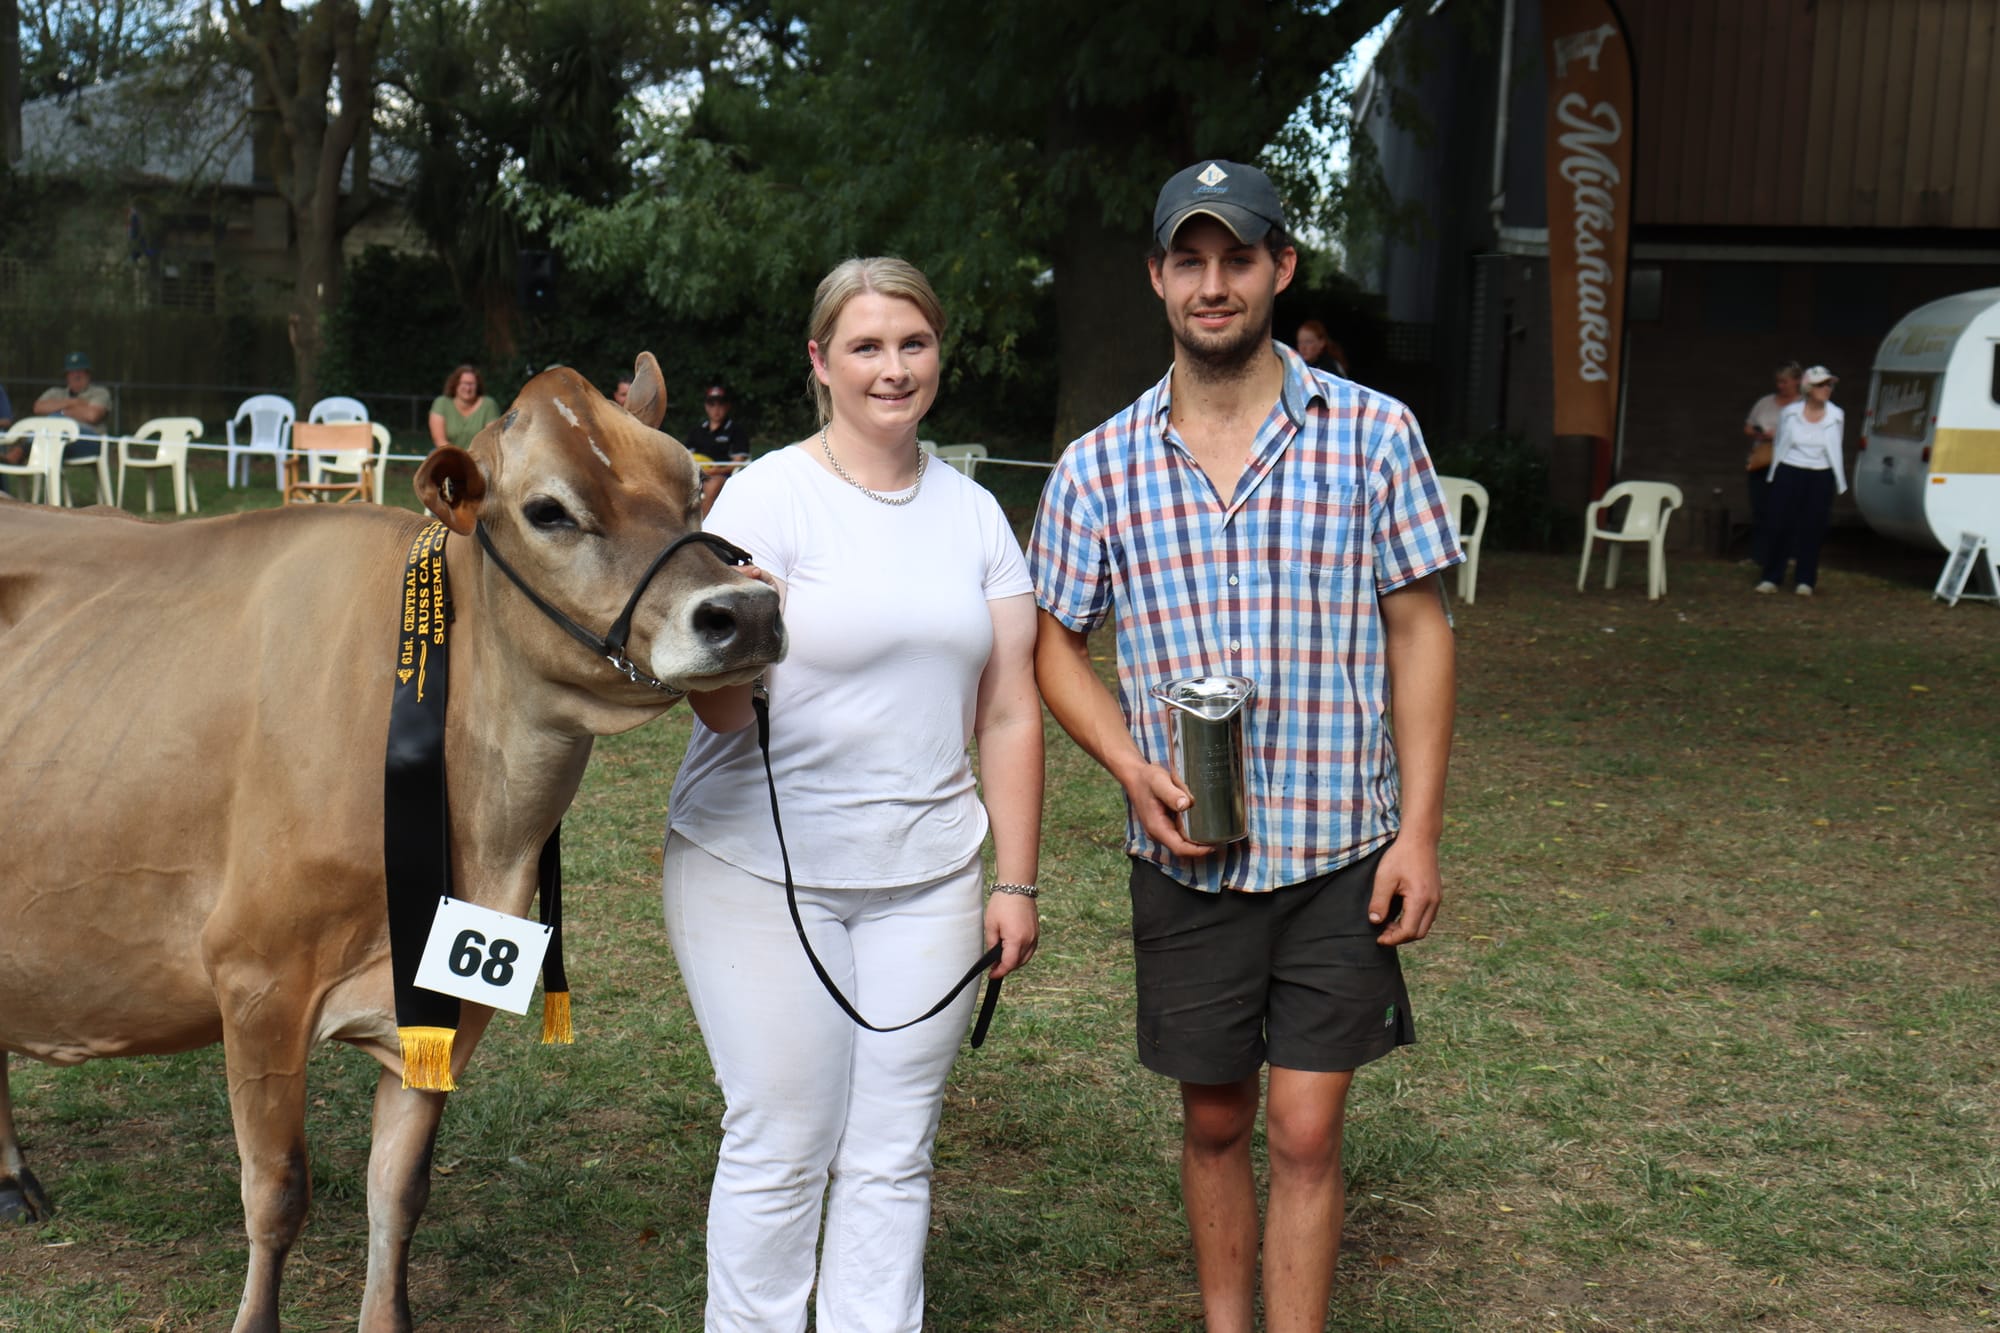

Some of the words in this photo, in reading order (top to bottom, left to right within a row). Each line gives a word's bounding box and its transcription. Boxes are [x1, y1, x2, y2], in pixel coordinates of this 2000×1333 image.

[1557, 92, 1622, 383] Milkshakes
[404, 568, 416, 632] CENTRAL
[418, 588, 430, 636] RUSS
[432, 556, 444, 645] SUPREME
[449, 929, 519, 987] 68
